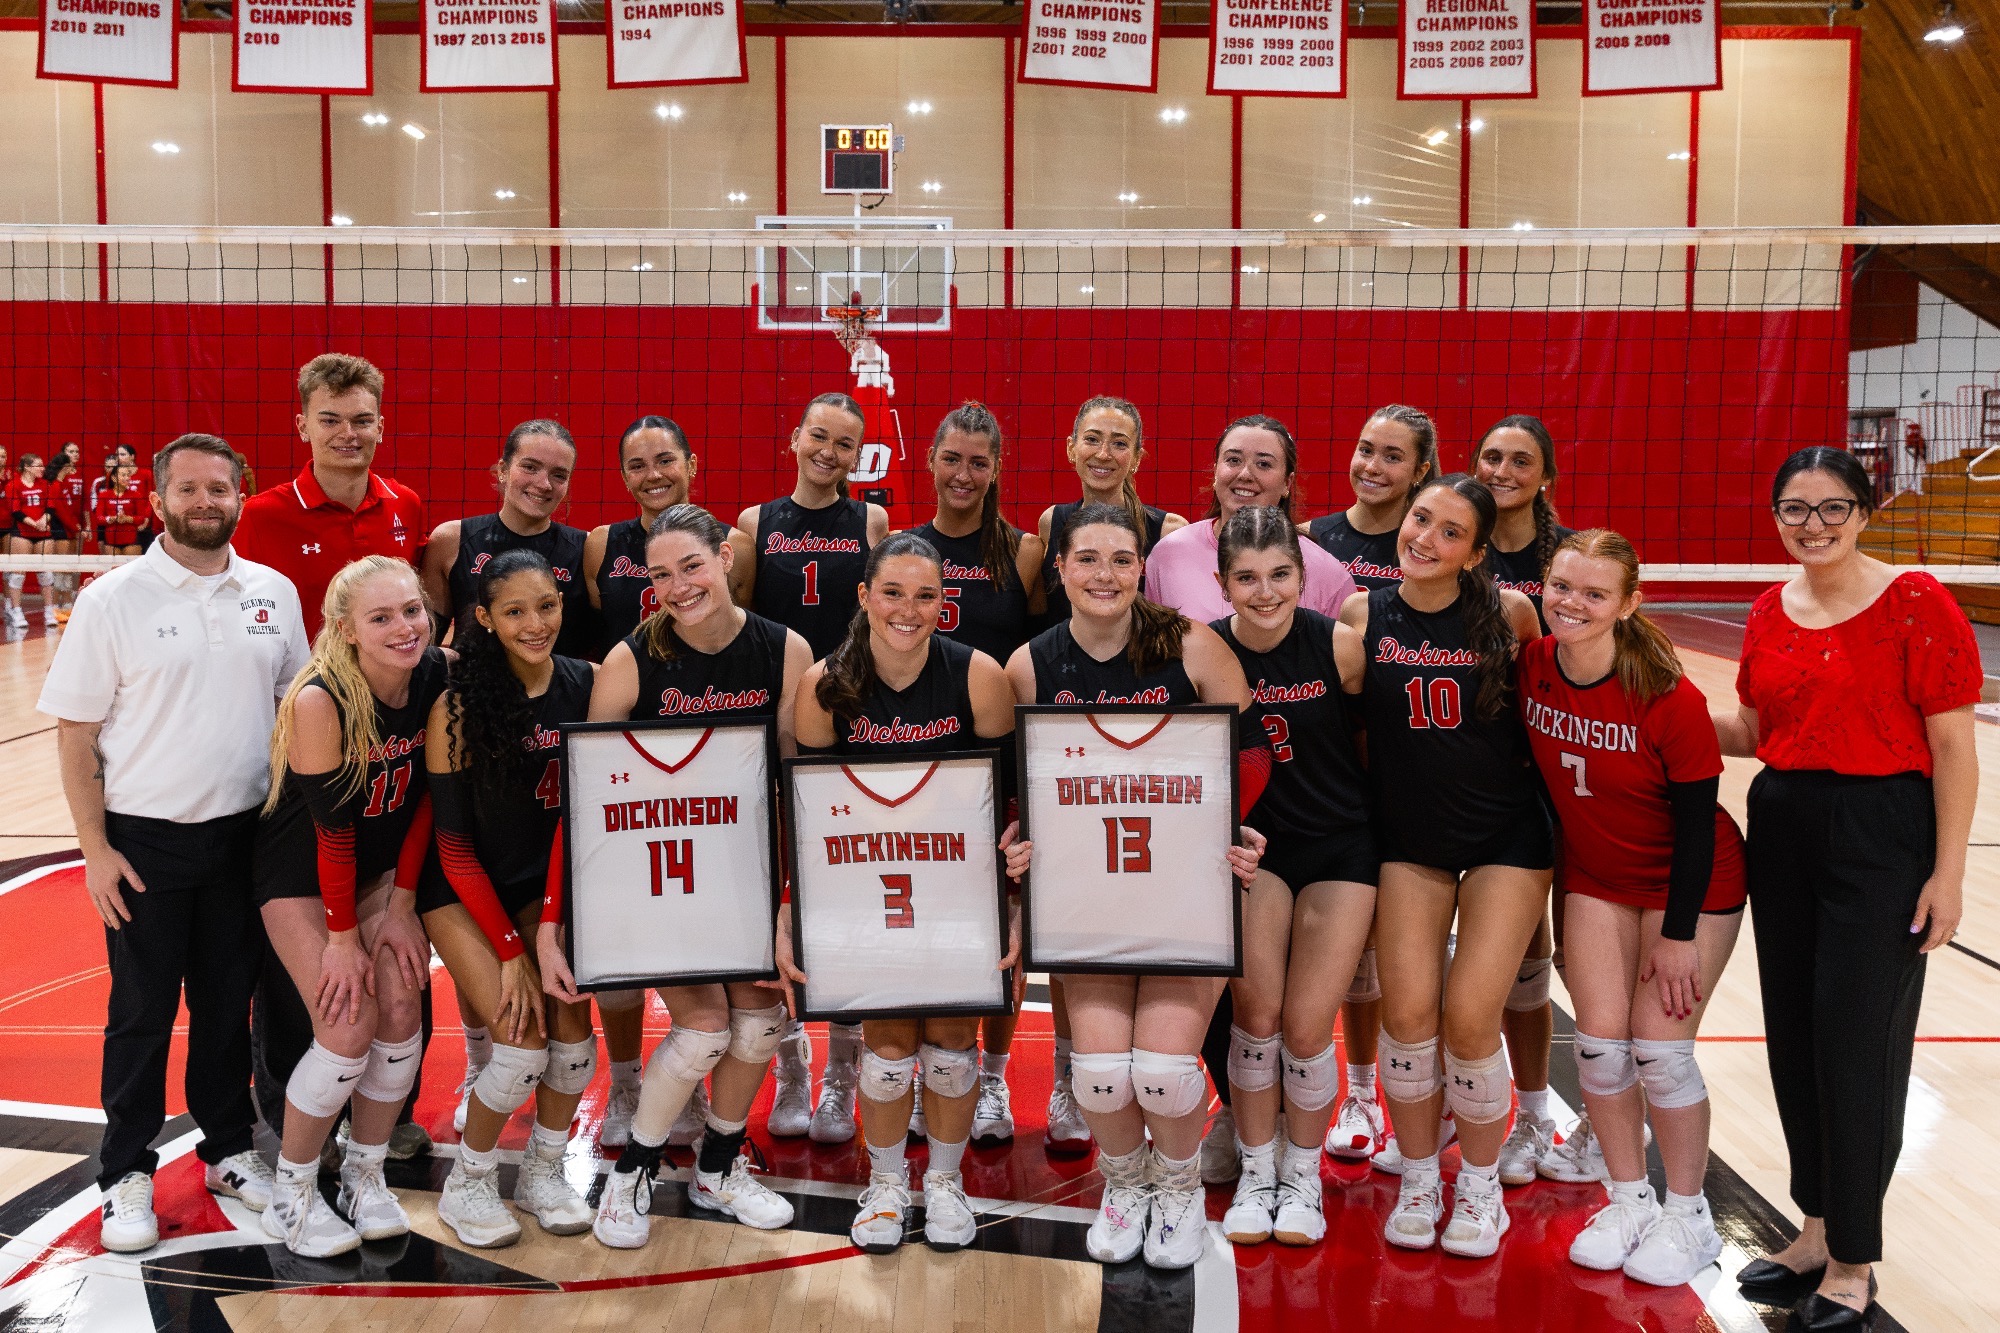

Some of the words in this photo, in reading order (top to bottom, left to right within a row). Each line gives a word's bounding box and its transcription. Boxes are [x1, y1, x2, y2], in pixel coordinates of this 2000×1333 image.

[57, 0, 161, 18] CHAMPIONS
[623, 1, 725, 20] CHAMPIONS
[1041, 3, 1143, 24] CHAMPIONS
[1426, 0, 1509, 13] REGIONAL
[249, 8, 353, 27] CHAMPIONS
[437, 9, 539, 25] CHAMPIONS
[1228, 13, 1330, 31] CHAMPIONS
[1416, 16, 1519, 32] CHAMPIONS
[1600, 9, 1703, 28] CHAMPIONS
[50, 20, 87, 33] 2010
[93, 22, 125, 36] 2011
[620, 28, 651, 41] 1994
[1035, 25, 1067, 39] 1996
[1075, 28, 1107, 42] 1999
[1112, 31, 1147, 45] 2000
[244, 32, 280, 45] 2010
[471, 33, 507, 45] 2013
[510, 32, 546, 45] 2015
[1223, 37, 1255, 49] 1996
[1262, 38, 1294, 50] 1999
[1299, 39, 1335, 51] 2000
[1412, 41, 1444, 53] 1999
[1450, 40, 1485, 52] 2002
[1490, 39, 1524, 51] 2003
[1032, 42, 1065, 56] 2001
[1071, 45, 1107, 59] 2002
[1220, 53, 1253, 66] 2001
[1260, 54, 1295, 67] 2002
[1299, 55, 1334, 67] 2003
[1409, 57, 1445, 69] 2005
[1449, 56, 1485, 69] 2006
[1489, 54, 1524, 67] 2007
[765, 531, 861, 555] Dickinson
[802, 560, 820, 605] 1
[240, 598, 276, 612] DICKINSON
[937, 587, 962, 632] 5
[246, 625, 281, 635] VOLLEYBALL
[659, 685, 770, 716] Dickinson
[1405, 676, 1463, 729] 10
[848, 715, 961, 744] Dickinson
[1526, 696, 1638, 753] DICKINSON
[1260, 714, 1294, 763] 2
[535, 758, 561, 810] 4
[1560, 751, 1594, 798] 7
[1055, 775, 1203, 806] DICKINSON
[602, 796, 738, 832] DICKINSON
[823, 831, 966, 866] DICKINSON
[1102, 816, 1152, 873] 13
[646, 839, 695, 897] 14
[878, 873, 915, 930] 3
